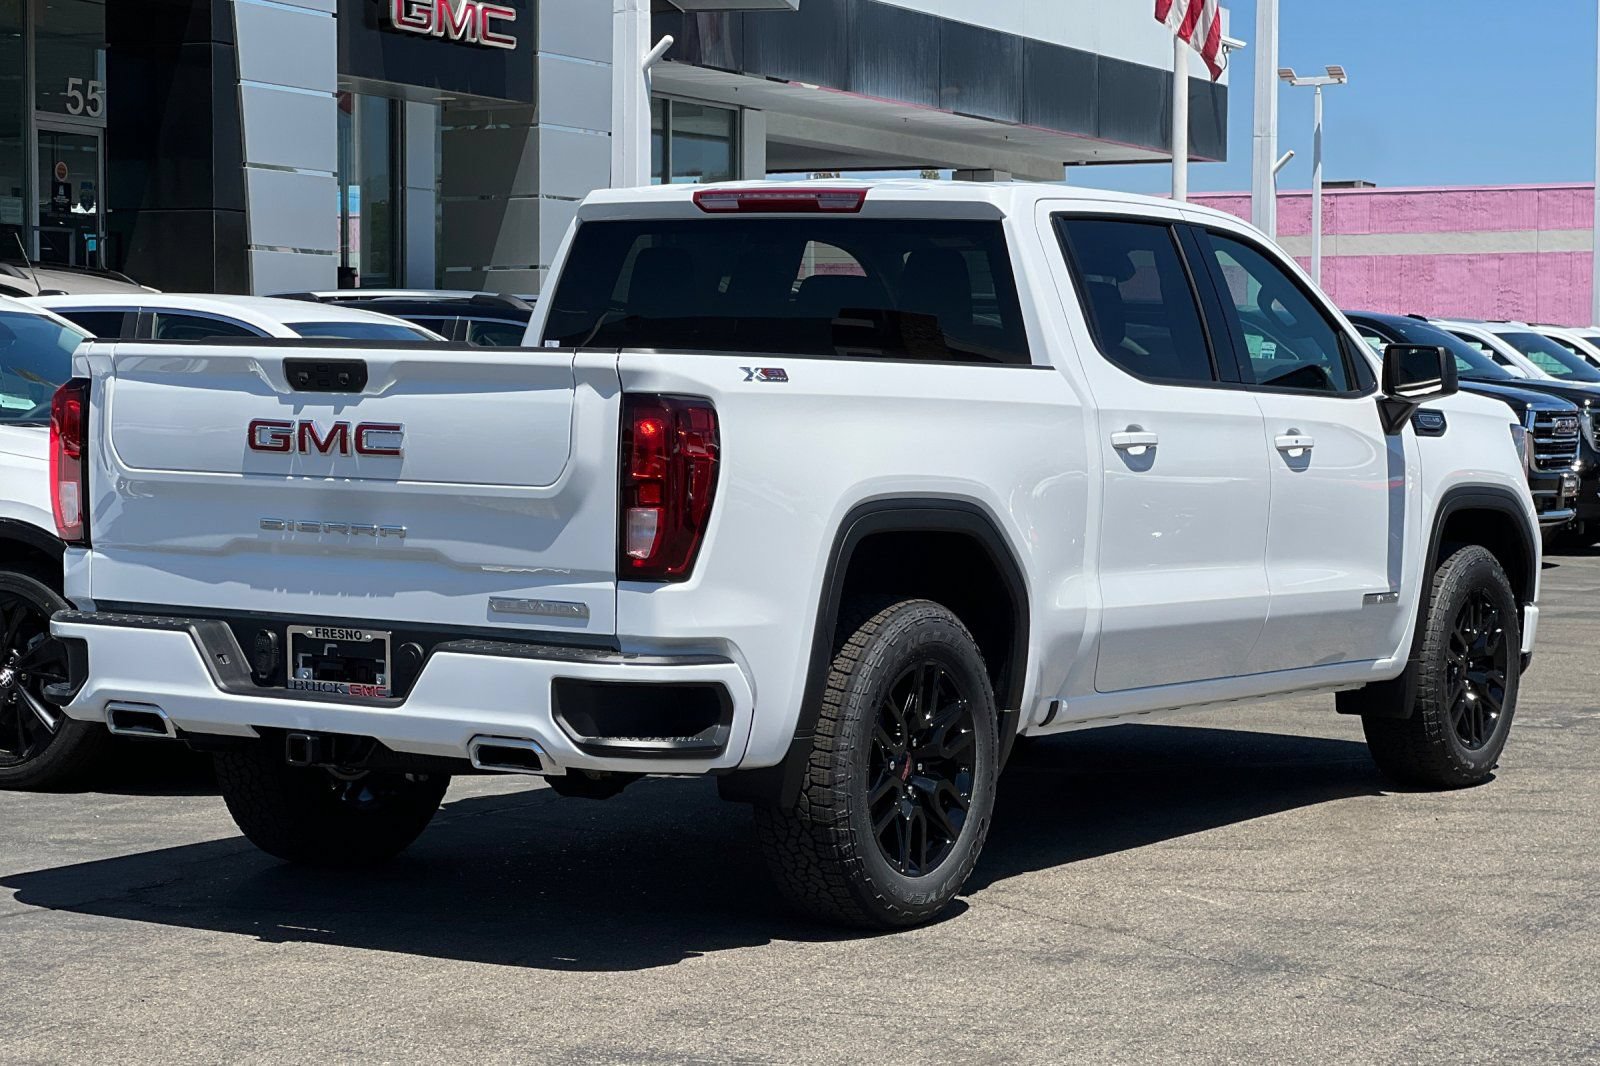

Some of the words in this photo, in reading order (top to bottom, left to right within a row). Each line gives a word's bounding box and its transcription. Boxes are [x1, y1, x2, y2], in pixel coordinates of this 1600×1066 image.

[391, 0, 517, 49] GMC
[66, 77, 103, 117] 55
[248, 418, 405, 459] GMC
[259, 518, 407, 538] SIERRA
[315, 628, 362, 640] FRESNO
[294, 680, 344, 694] BUICK
[348, 684, 387, 698] GMC
